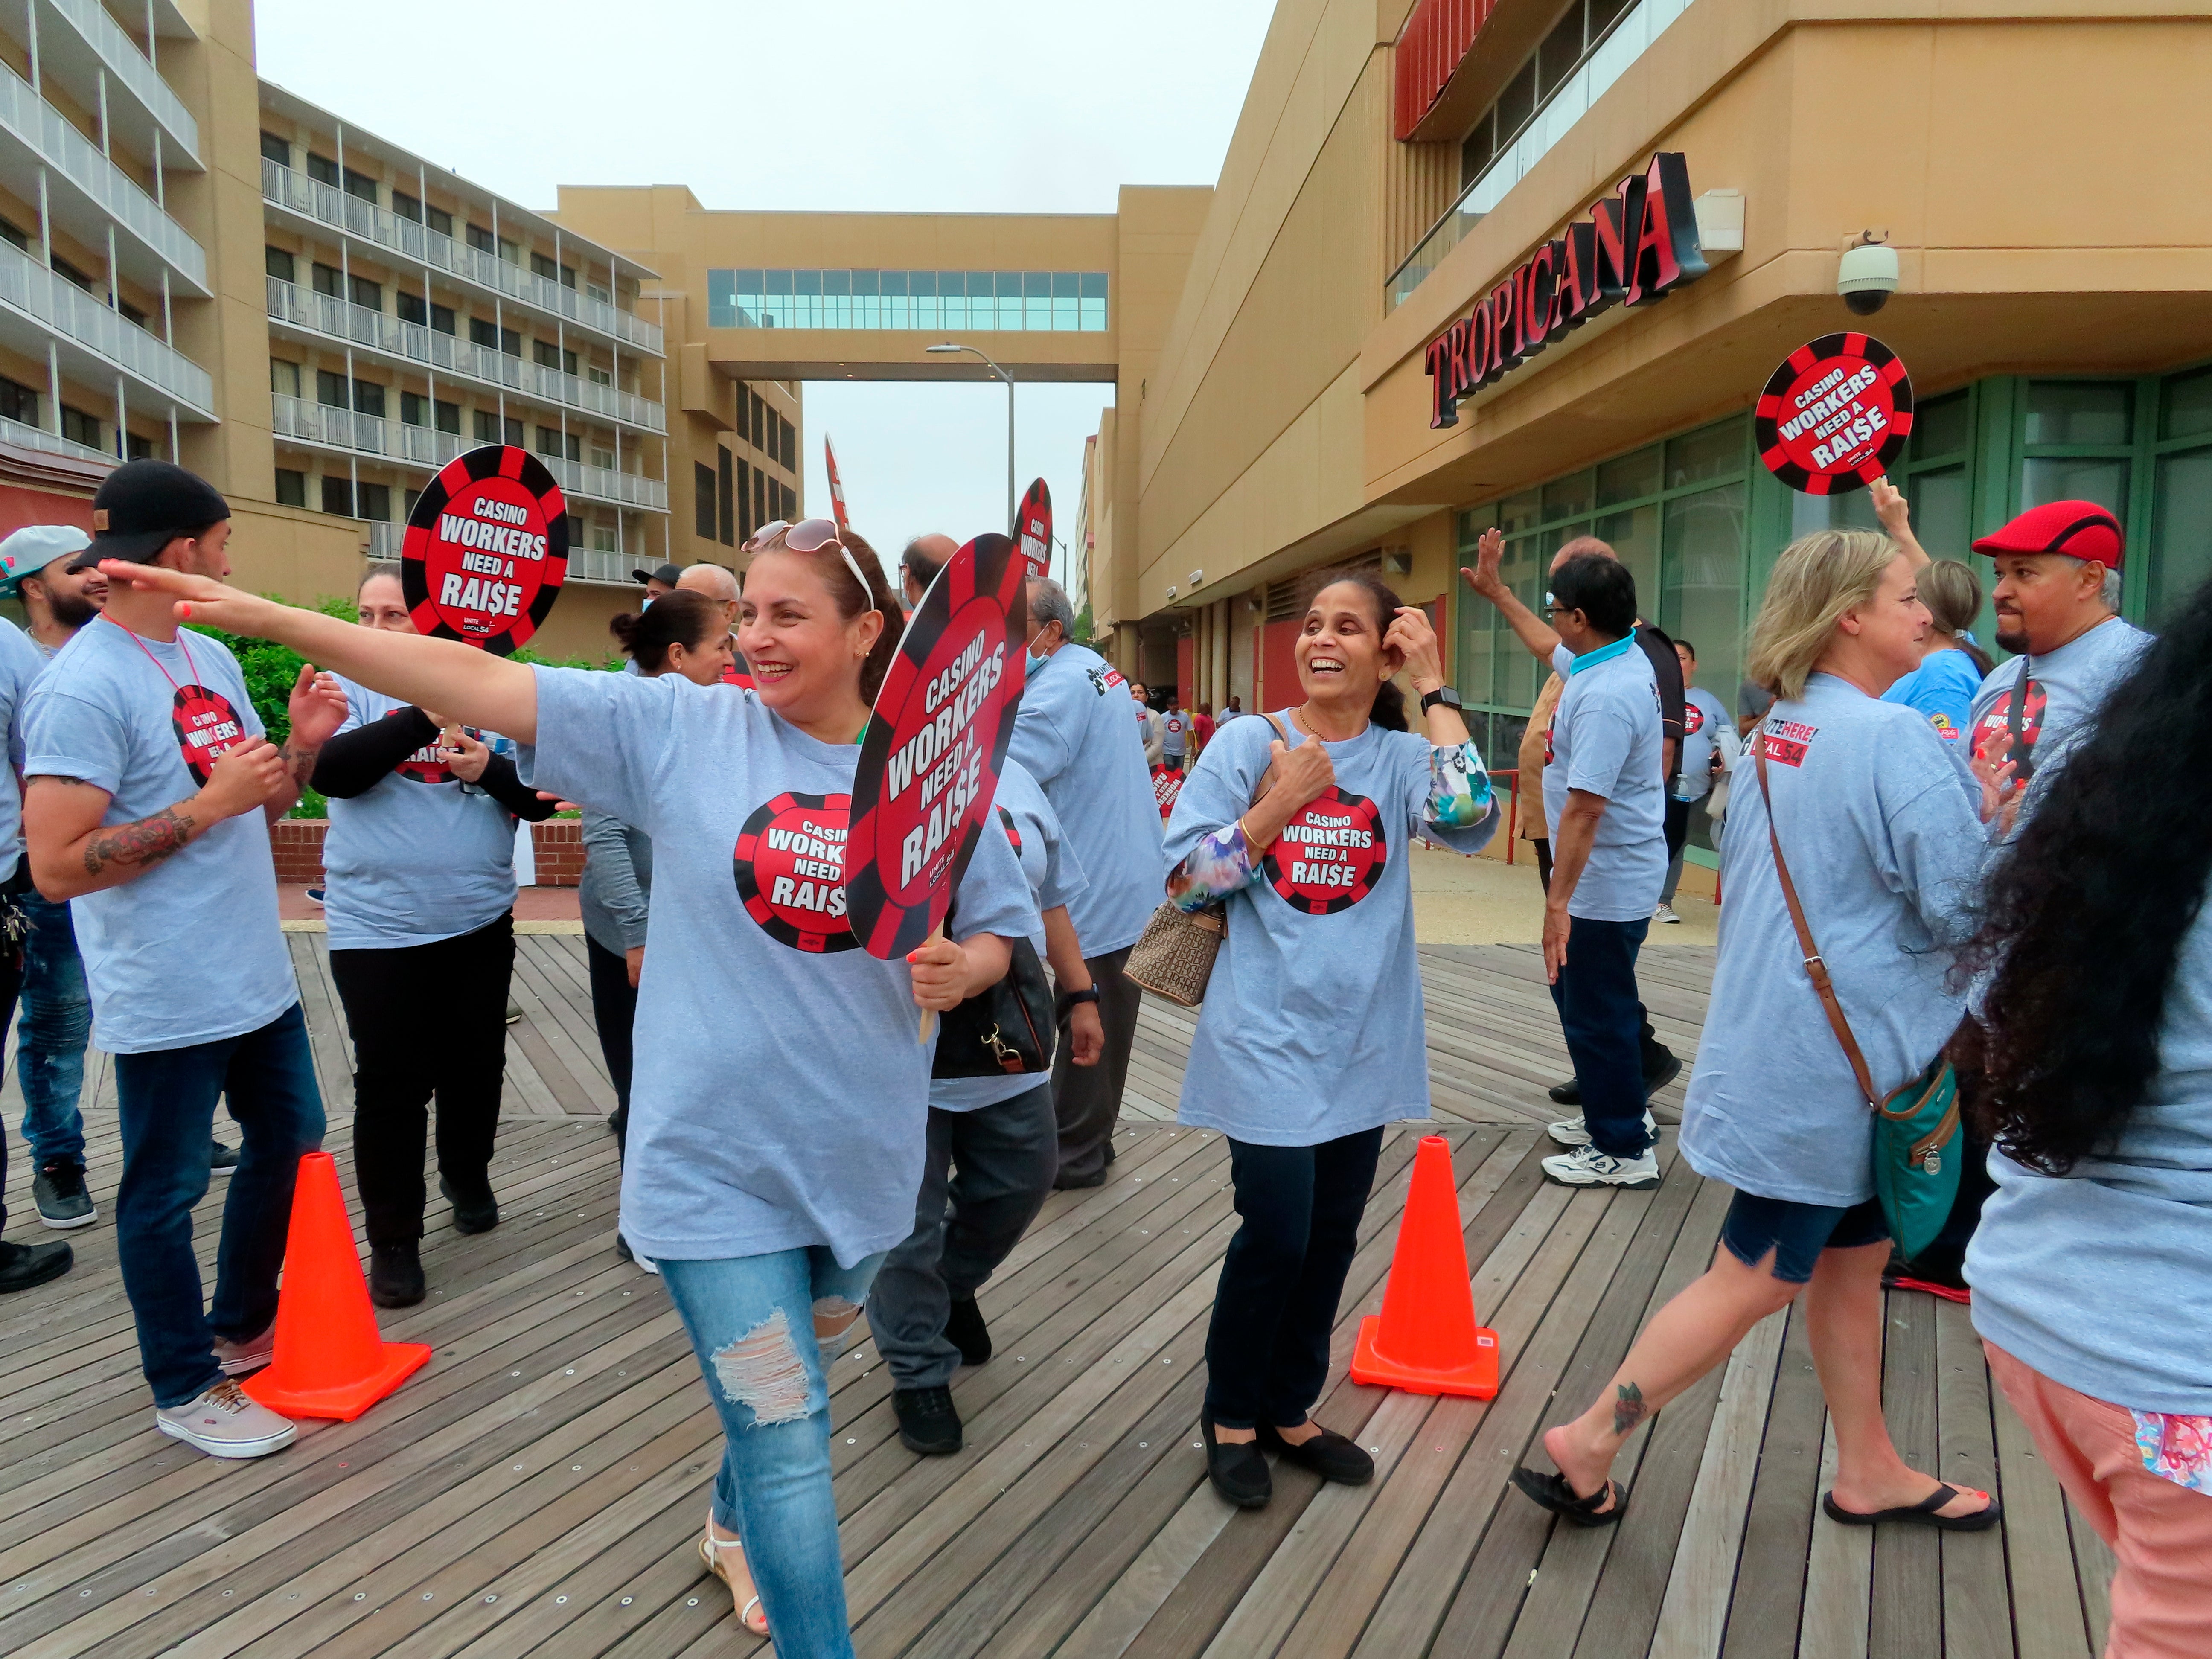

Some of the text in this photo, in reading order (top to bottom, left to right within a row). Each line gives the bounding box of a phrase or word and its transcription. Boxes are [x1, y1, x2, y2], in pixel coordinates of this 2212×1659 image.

[1425, 152, 1700, 429] TROPICANA
[1794, 367, 1845, 409] CASINO
[1778, 364, 1877, 442] WORKERS
[1813, 400, 1865, 441] NEED A
[473, 497, 528, 526] CASINO
[440, 513, 546, 561] WORKERS
[1021, 533, 1047, 564] WORKERS
[462, 552, 515, 578] NEED A
[925, 629, 985, 714] CASINO
[1096, 663, 1112, 675] UNIT
[1106, 672, 1121, 685] LOCAL
[888, 641, 1004, 803] WORKERS
[920, 741, 963, 811] NEED
[964, 724, 974, 759] A
[1782, 744, 1804, 764] 54
[1159, 781, 1170, 793] NEED
[802, 820, 847, 842] CASIN
[1305, 812, 1351, 828] CASINO
[768, 827, 845, 864] WORK
[1282, 825, 1372, 849] WORKERS
[929, 854, 945, 878] UNITE
[1304, 846, 1348, 862] NEED A
[793, 858, 841, 882] NEED
[929, 863, 947, 888] LOCAL
[771, 876, 846, 919] RAI$
